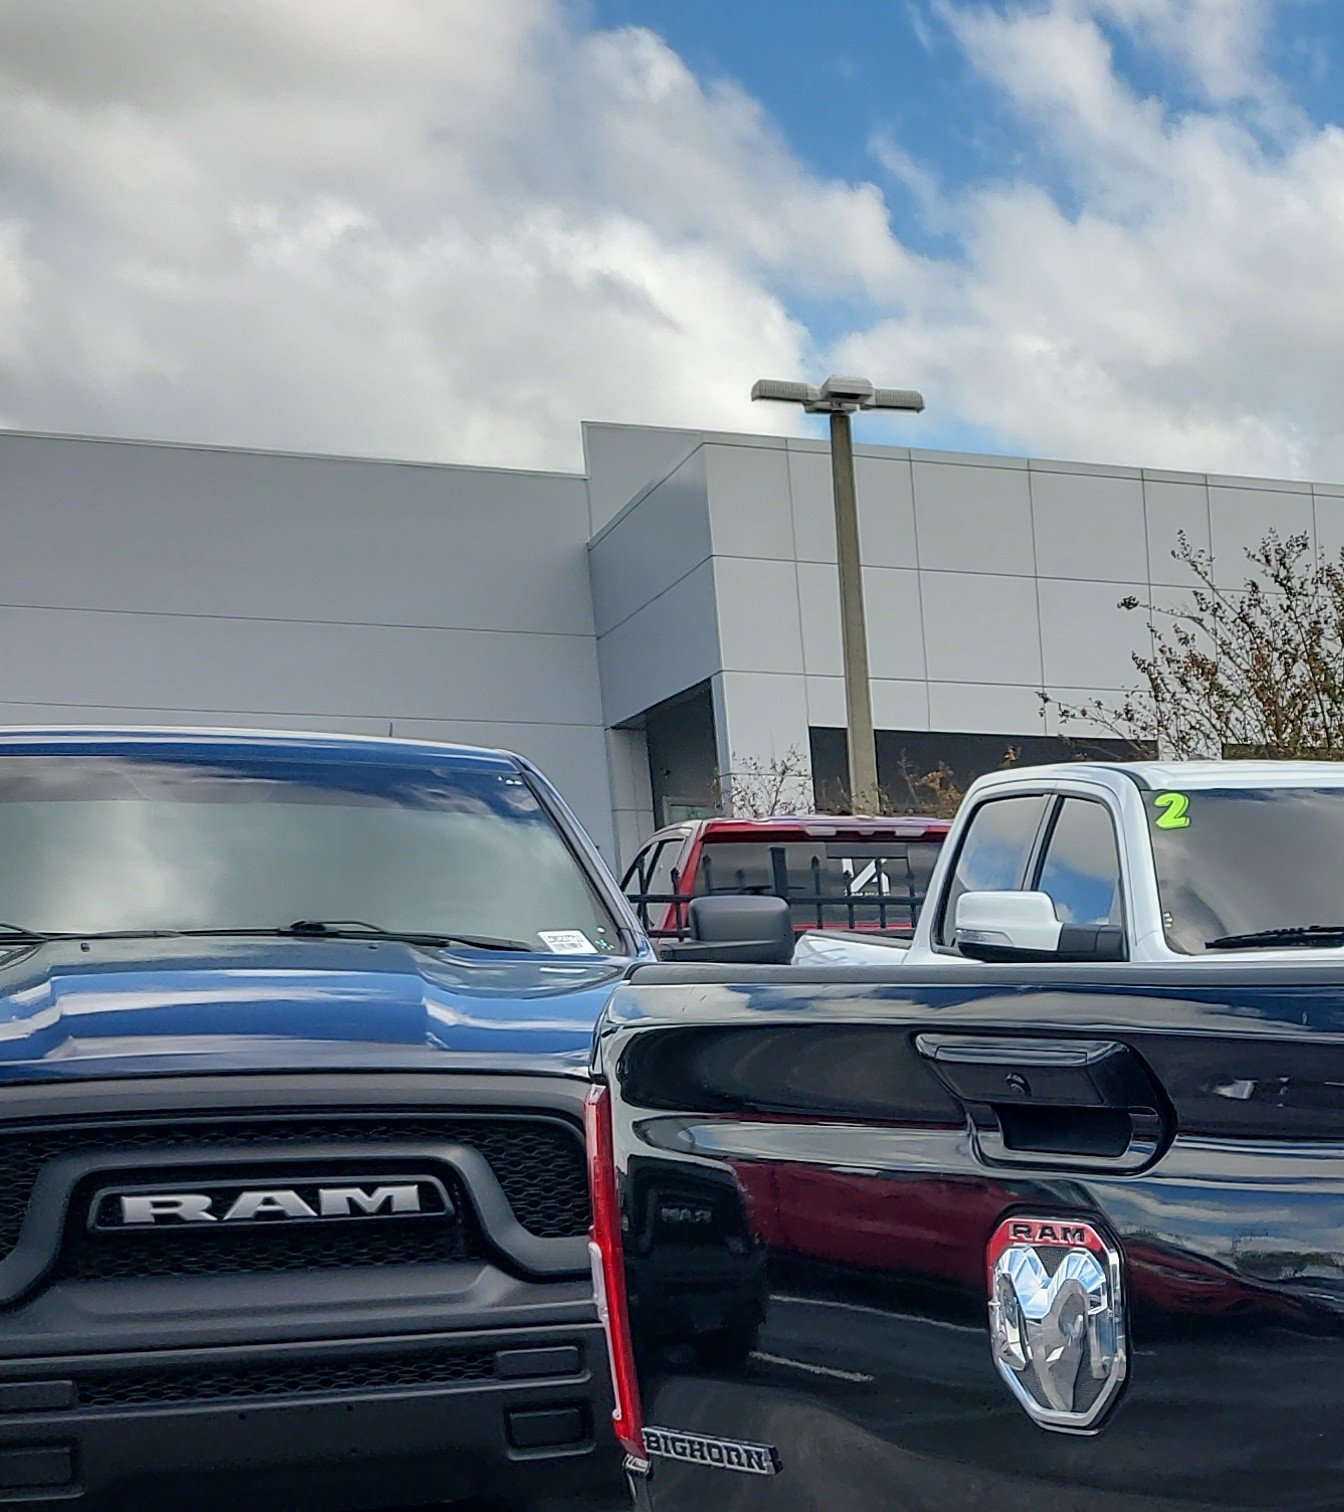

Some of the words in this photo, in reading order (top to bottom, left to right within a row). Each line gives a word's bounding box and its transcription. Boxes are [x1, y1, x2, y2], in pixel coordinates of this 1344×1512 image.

[1154, 792, 1190, 829] 2
[120, 1184, 421, 1224] RAM
[1008, 1222, 1088, 1244] RAM
[642, 1429, 771, 1474] BIGHORN
